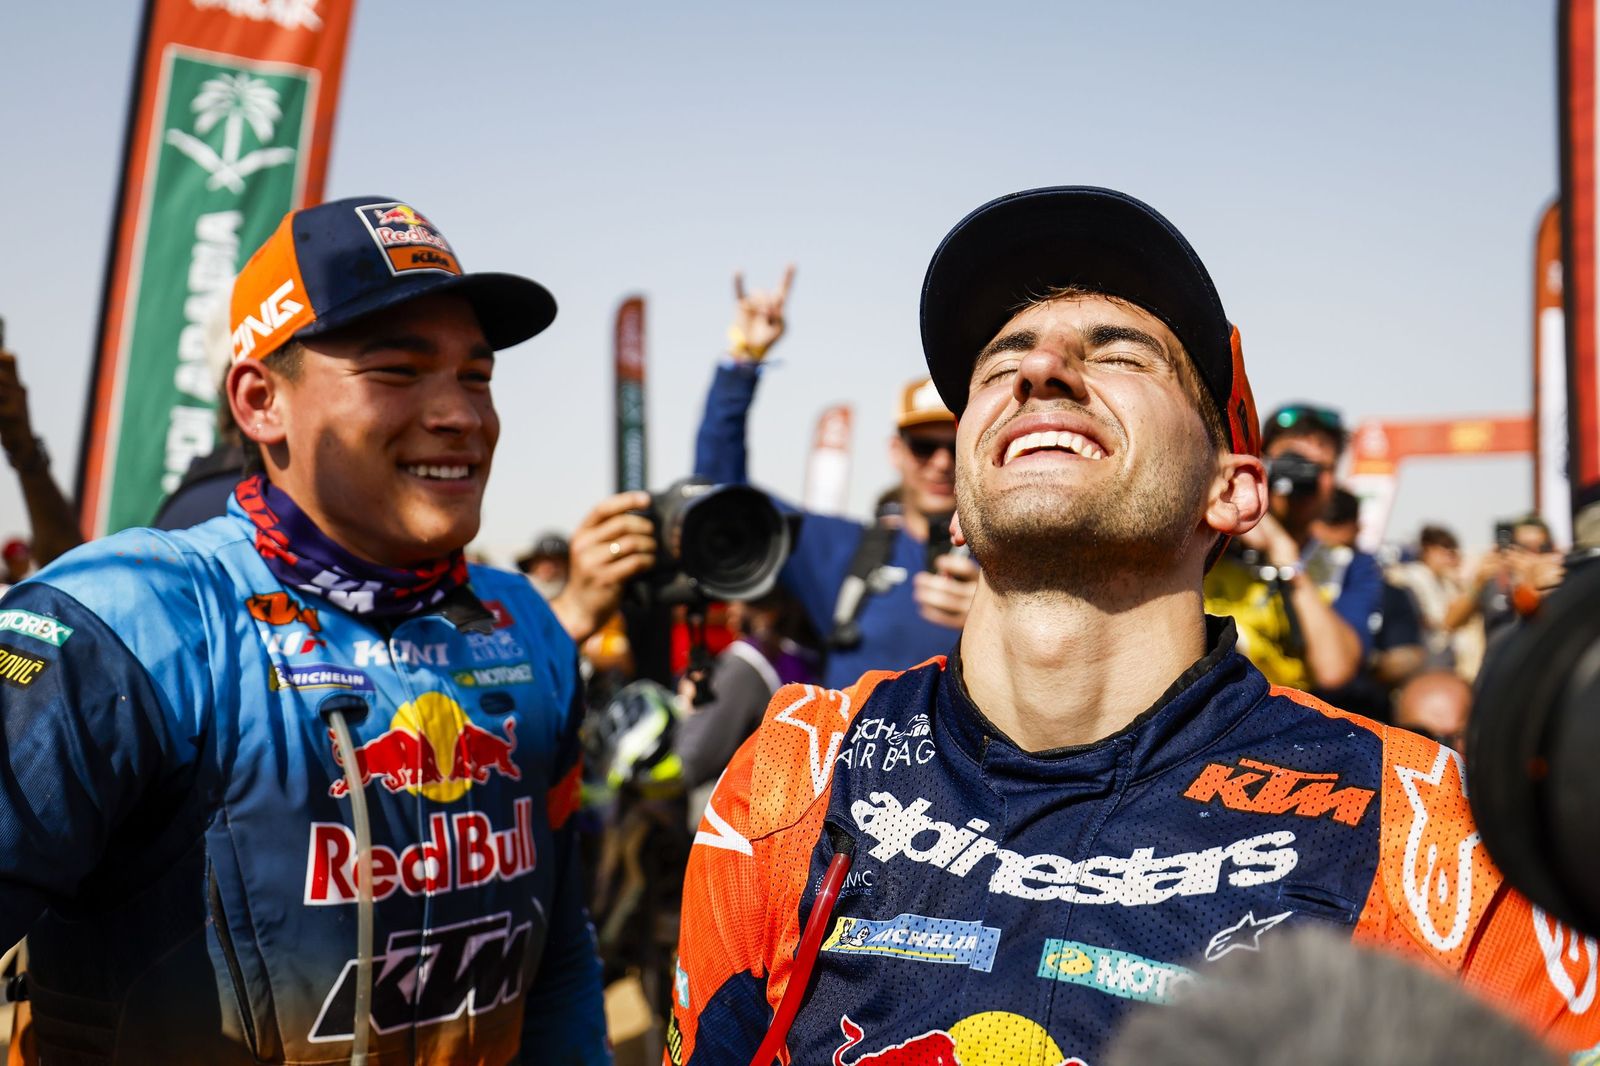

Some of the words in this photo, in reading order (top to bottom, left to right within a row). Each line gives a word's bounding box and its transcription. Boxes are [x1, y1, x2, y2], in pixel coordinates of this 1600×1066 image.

[411, 251, 449, 267] KTM
[1183, 758, 1376, 826] KTM
[851, 791, 1299, 906] alpinestars
[307, 911, 533, 1043] KTM
